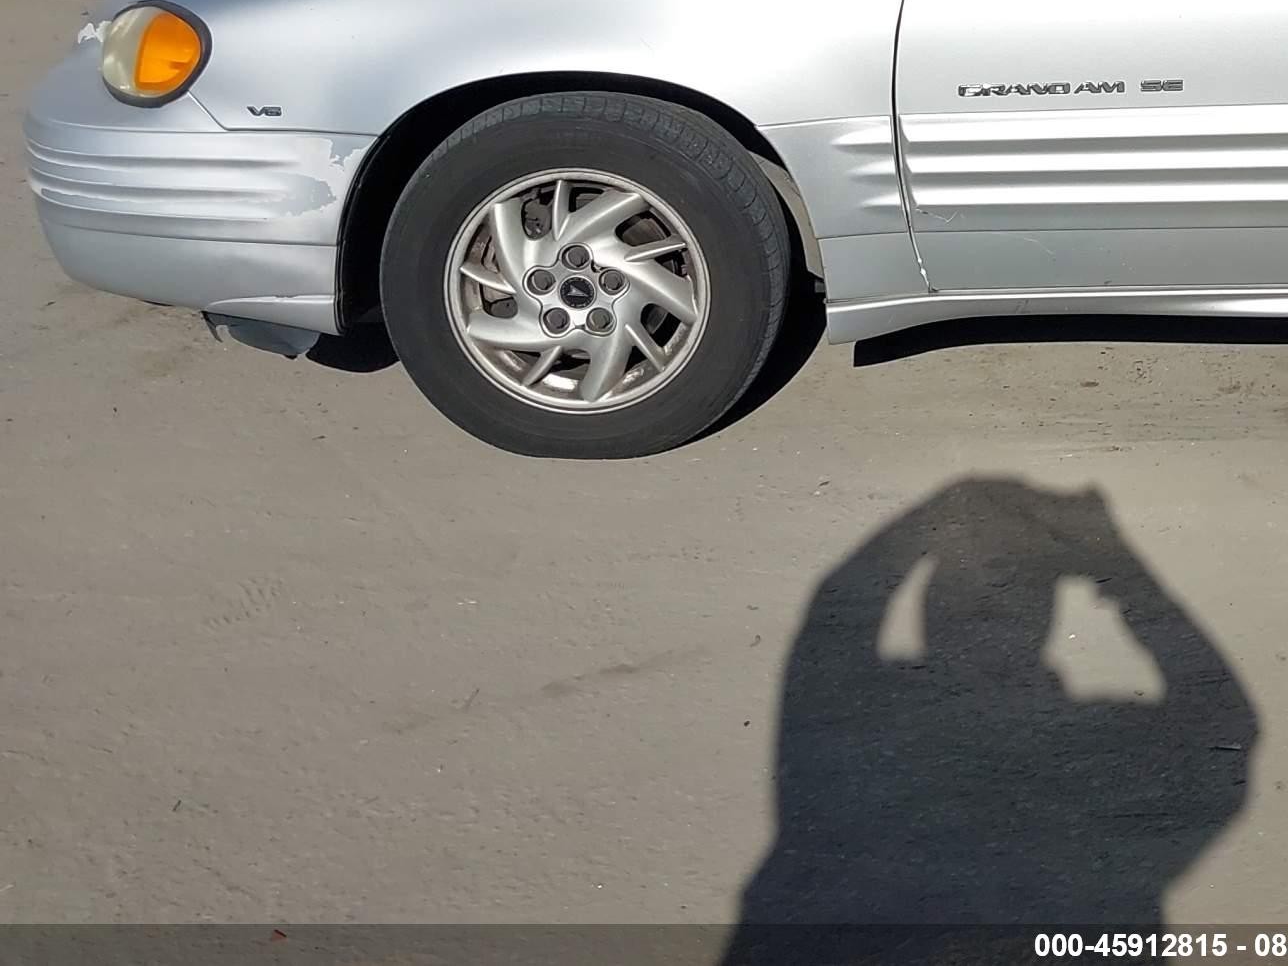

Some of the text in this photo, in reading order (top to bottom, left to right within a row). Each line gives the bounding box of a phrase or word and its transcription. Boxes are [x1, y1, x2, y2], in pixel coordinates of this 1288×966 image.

[957, 79, 1184, 97] GRAND AM SE
[246, 106, 282, 117] V6
